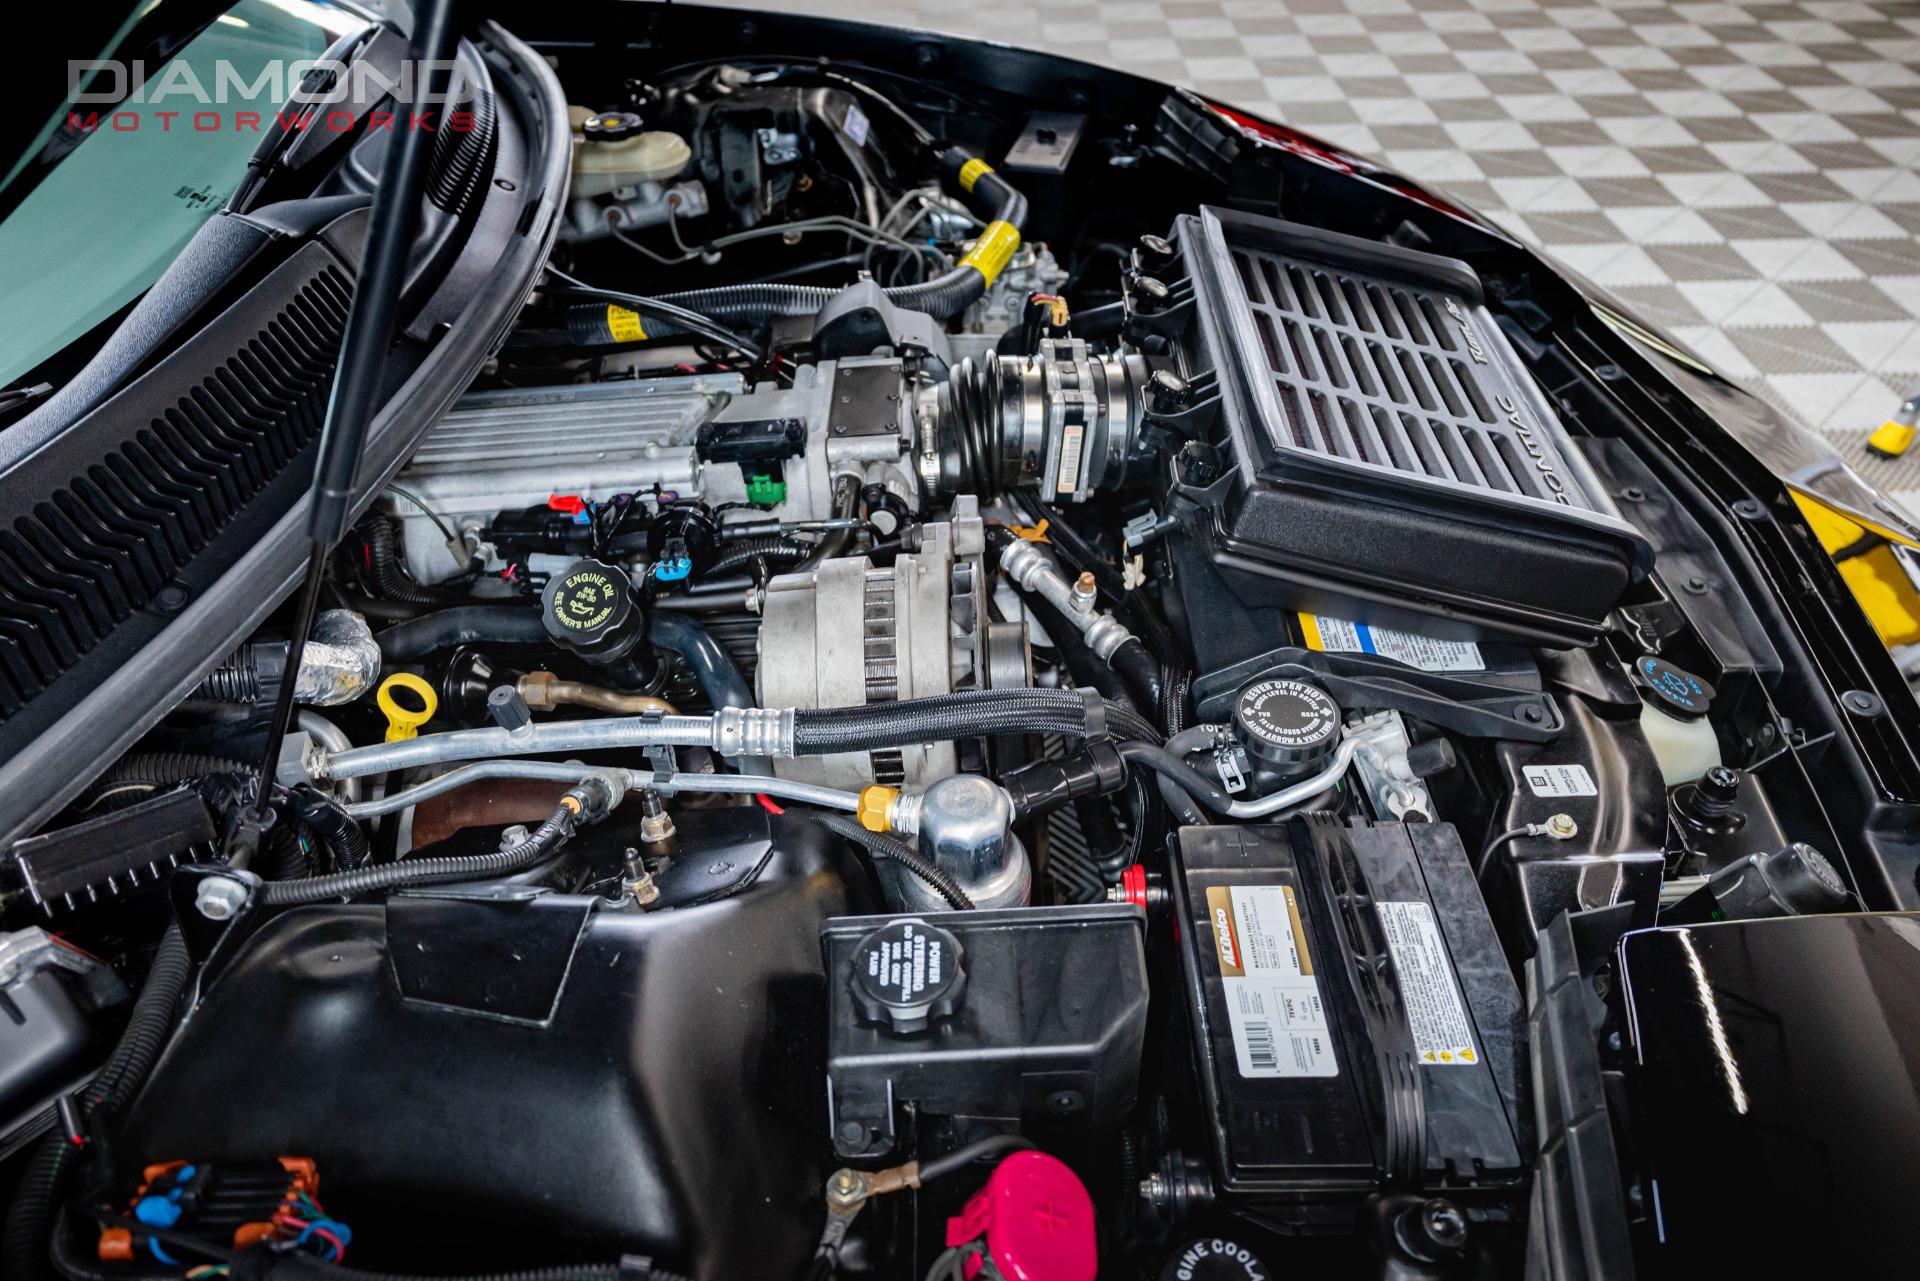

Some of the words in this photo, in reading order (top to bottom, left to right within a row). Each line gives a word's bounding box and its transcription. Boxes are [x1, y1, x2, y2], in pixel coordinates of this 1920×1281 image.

[565, 572, 607, 588] ENGINE
[602, 583, 615, 600] OIL
[575, 590, 597, 603] 5W-30
[554, 591, 564, 606] SEE
[555, 606, 582, 629] OWNER'S
[583, 606, 613, 629] MANUAL
[1244, 682, 1273, 702] NEVER
[1274, 681, 1303, 692] OPEN
[1303, 686, 1325, 701] HOT
[1267, 688, 1288, 697] LEVEL
[1298, 692, 1320, 710] BOTTLE
[1246, 719, 1267, 736] ALIGN
[1266, 732, 1295, 744] ARROW
[1304, 733, 1321, 743] VENT
[1275, 726, 1301, 736] CLOSED
[1300, 717, 1321, 733] SYSTEM
[904, 925, 913, 939] DO
[1216, 908, 1236, 967] ACDelco
[892, 942, 901, 960] USE
[903, 940, 913, 959] NOT
[869, 951, 879, 976] FLUID
[879, 941, 890, 986] APPROVED
[891, 962, 901, 985] ONLY
[912, 934, 926, 992] STEERING
[929, 941, 941, 984] POWER
[901, 961, 912, 1002] OVERFILL
[1176, 1241, 1210, 1281] GINE
